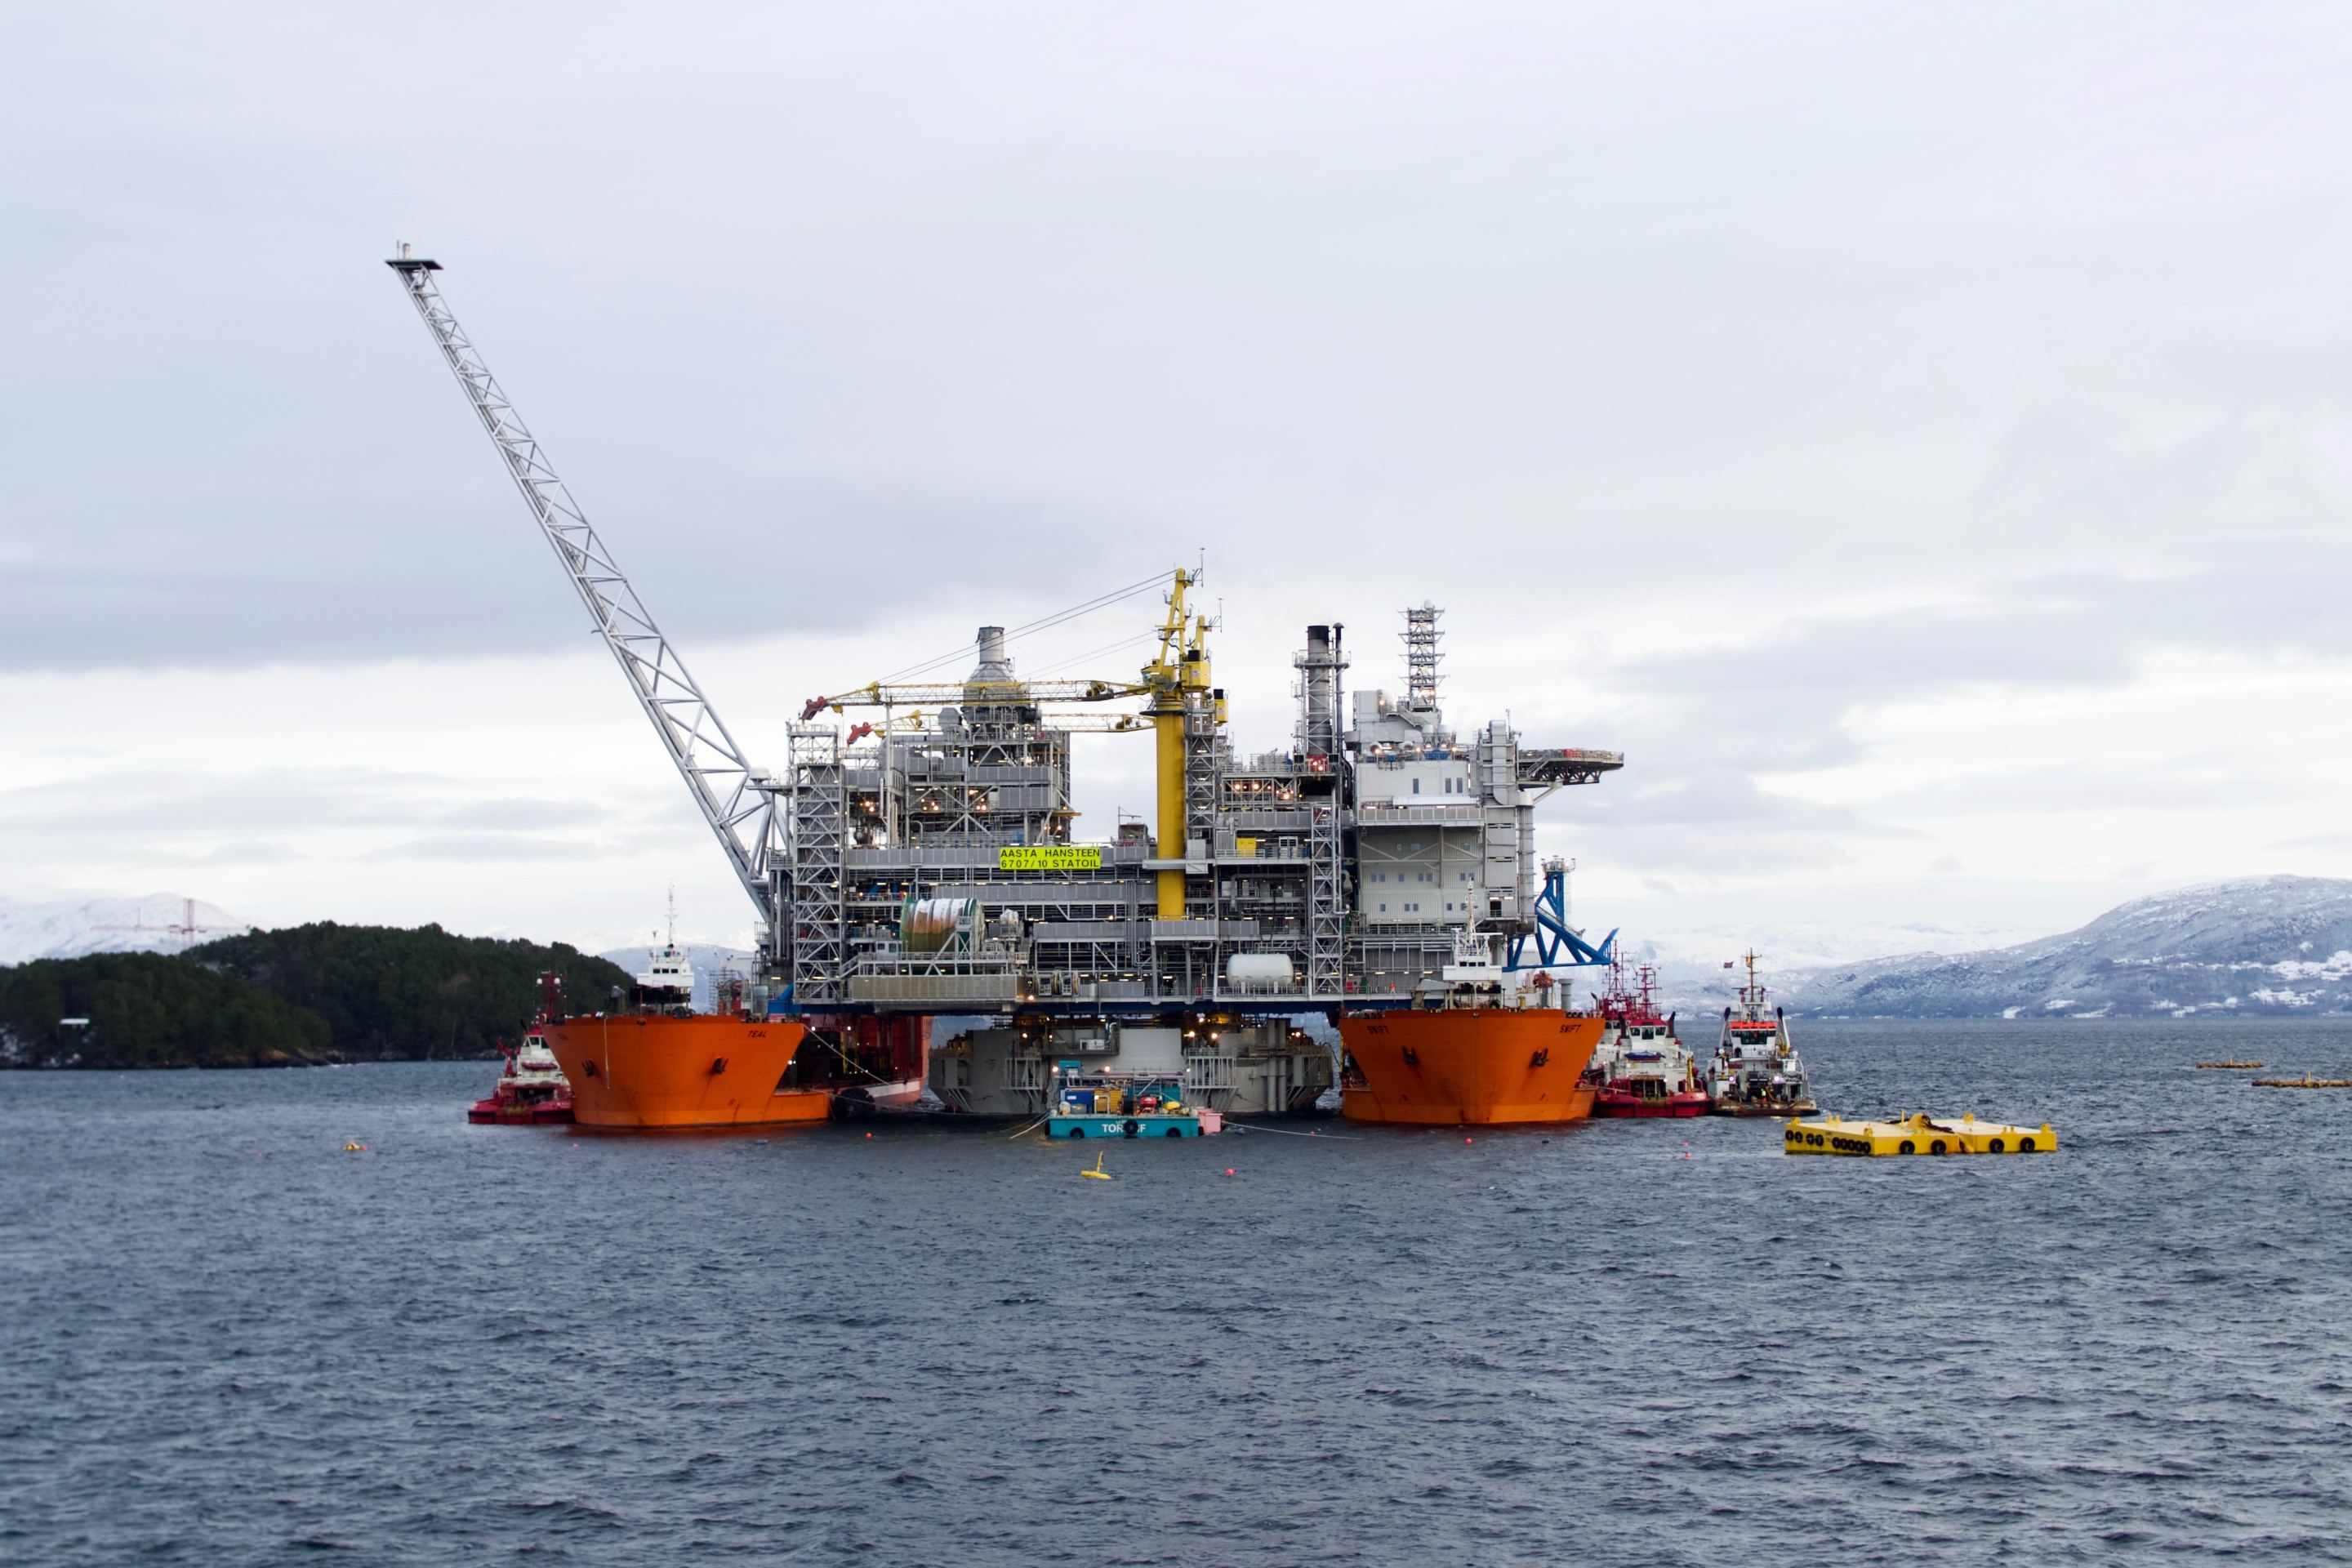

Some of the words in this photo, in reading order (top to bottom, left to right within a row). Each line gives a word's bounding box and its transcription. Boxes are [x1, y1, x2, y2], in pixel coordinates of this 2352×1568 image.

[1000, 849, 1037, 858] AASTA
[1045, 849, 1100, 858] HANSTEEN
[1001, 859, 1048, 868] 6707/10
[1053, 859, 1099, 867] STATOIL
[1560, 1024, 1582, 1033] SWIFT
[747, 1030, 768, 1038] TEAL
